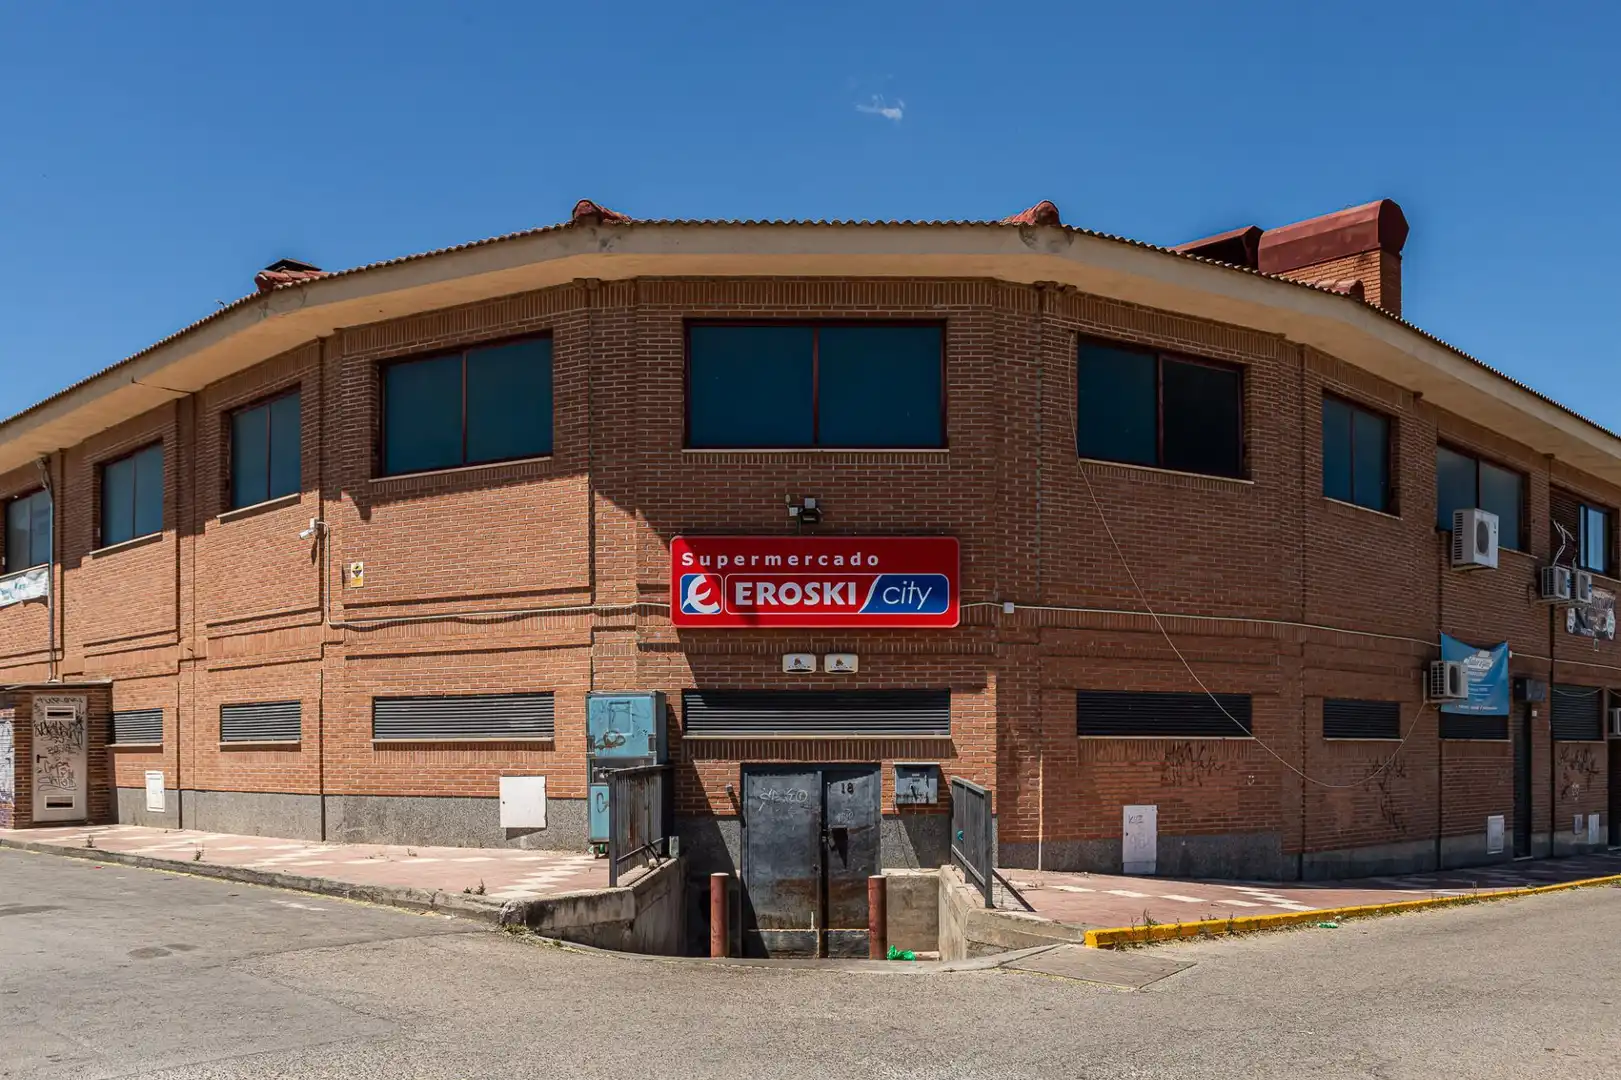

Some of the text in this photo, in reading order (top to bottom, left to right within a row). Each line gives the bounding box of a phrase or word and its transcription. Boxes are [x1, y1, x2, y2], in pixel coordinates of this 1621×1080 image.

[681, 552, 879, 569] Supermercado
[735, 581, 932, 610] EROSKI city
[841, 782, 854, 795] 18
